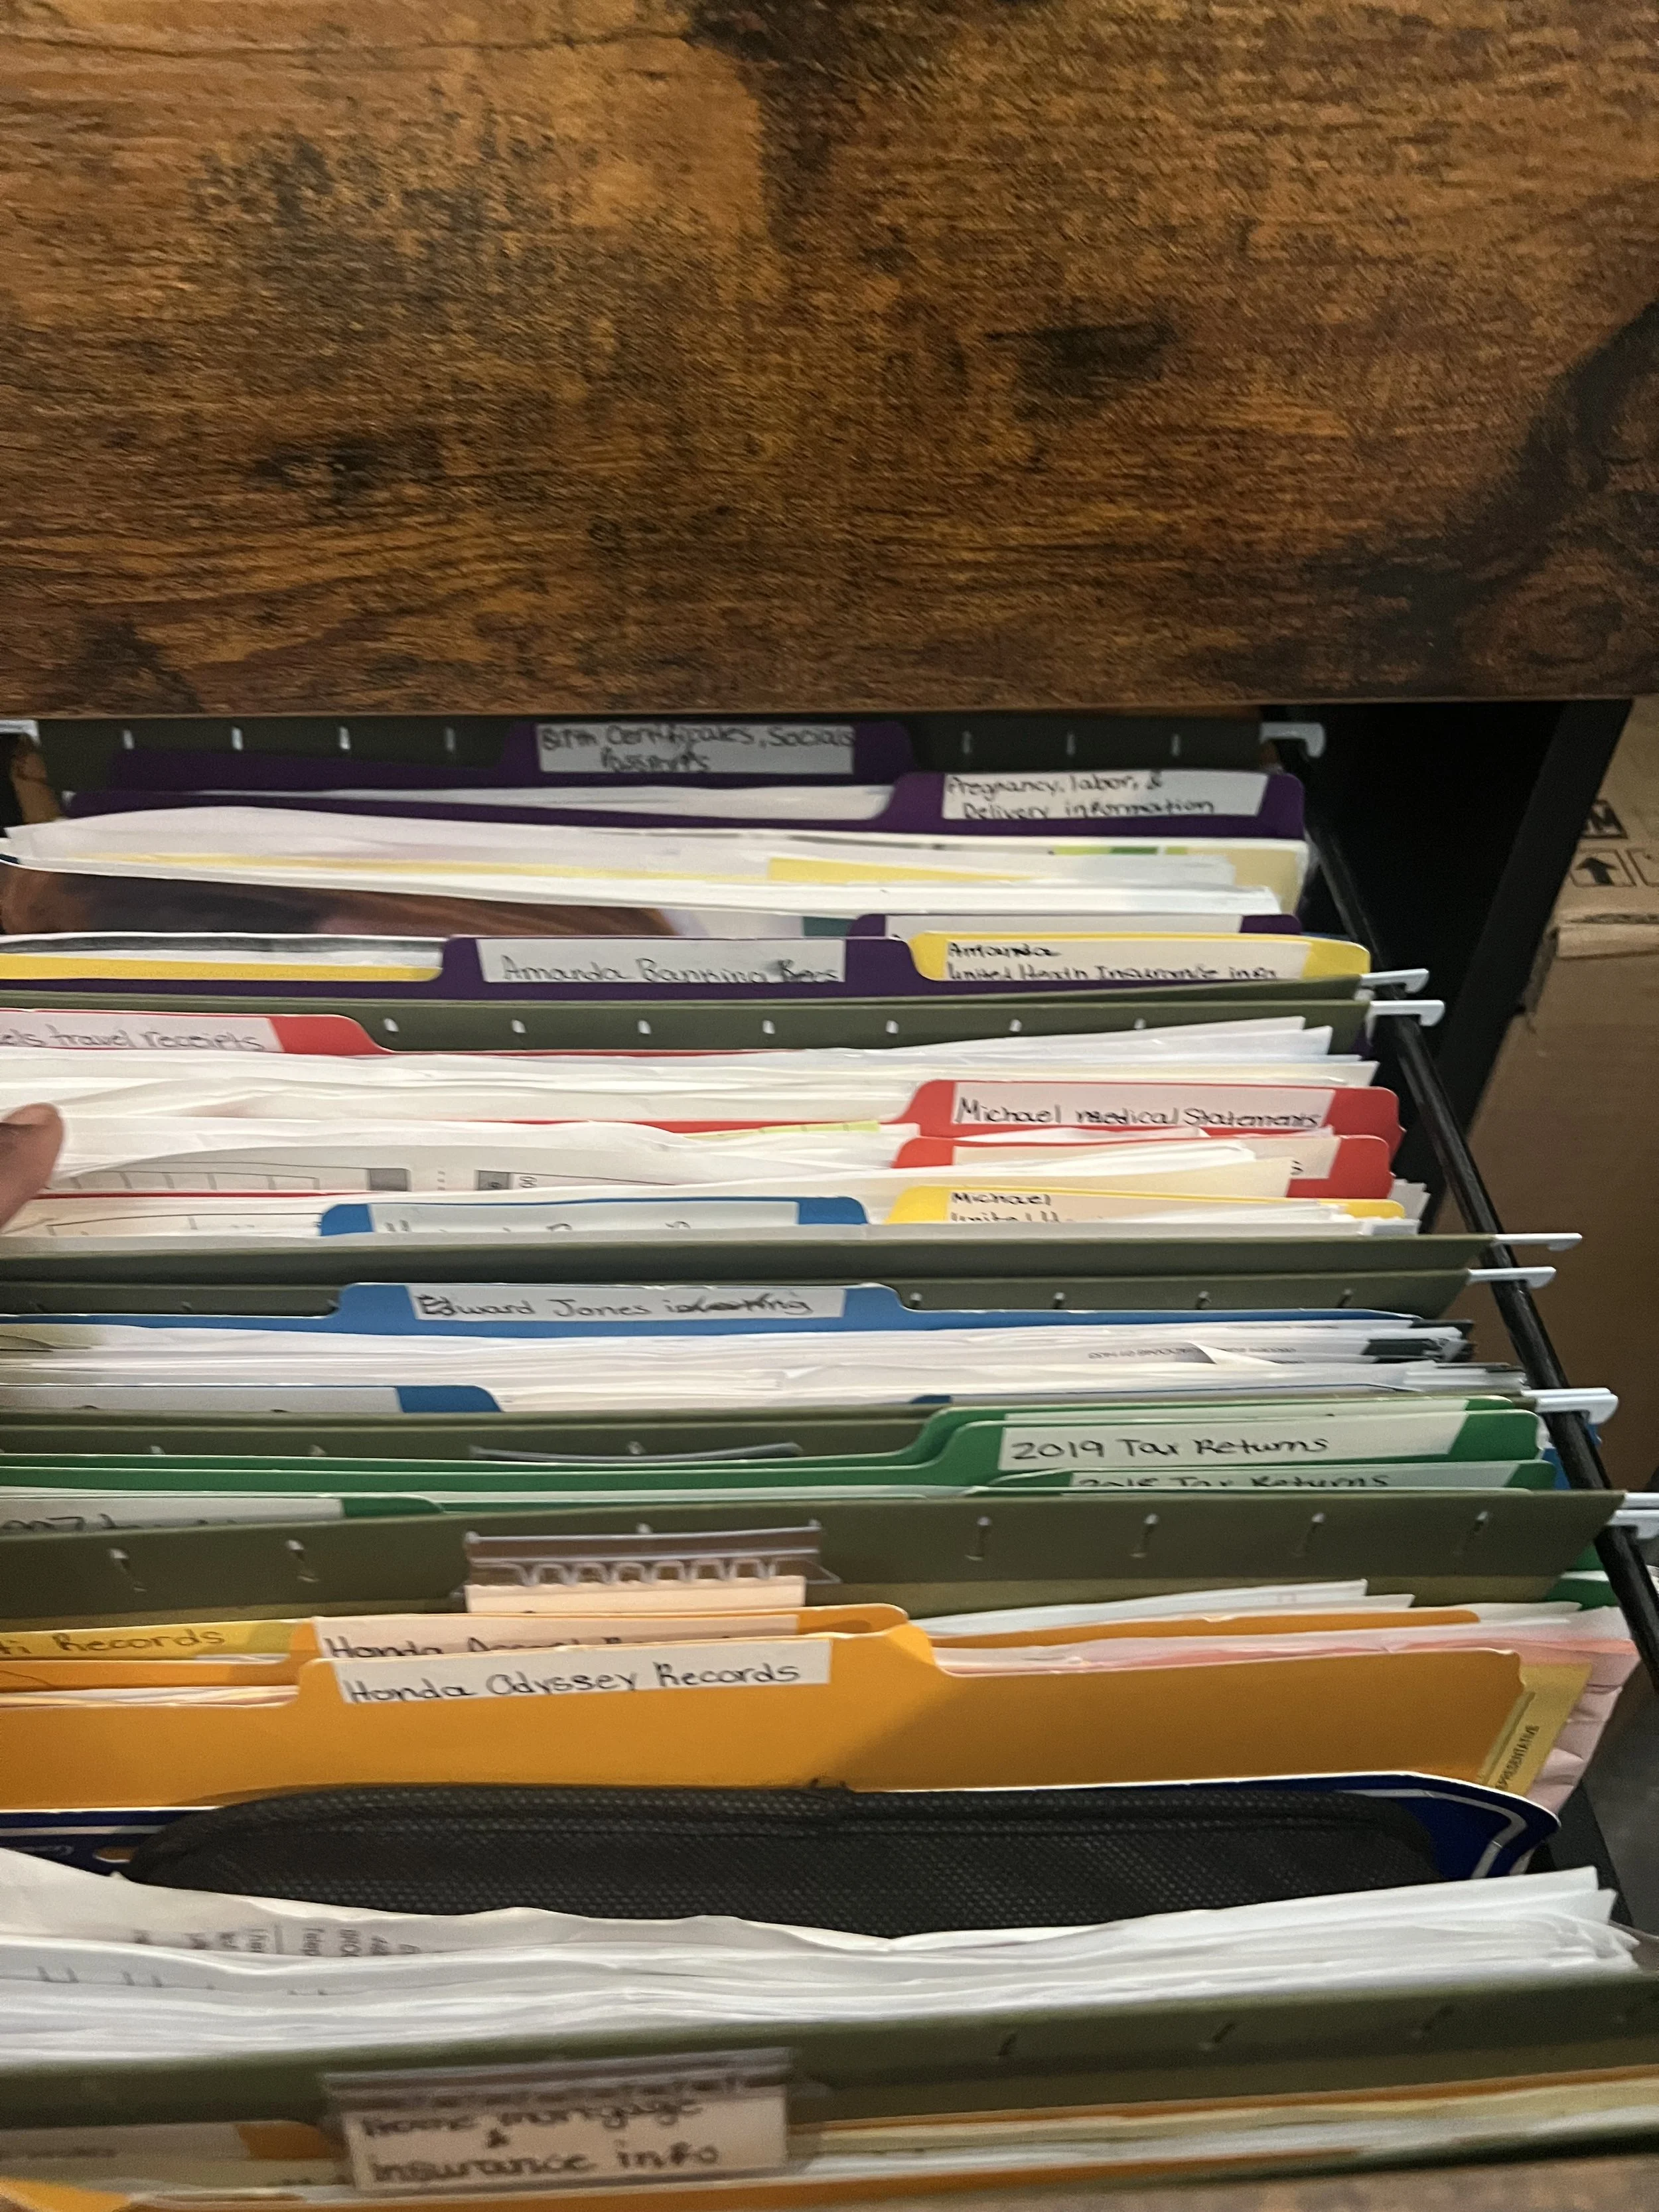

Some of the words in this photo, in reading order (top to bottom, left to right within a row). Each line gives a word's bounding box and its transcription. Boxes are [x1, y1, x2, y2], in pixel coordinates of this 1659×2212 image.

[948, 942, 1061, 958] Amanda
[501, 956, 626, 981] Amanda
[45, 1023, 133, 1049] travel
[954, 1096, 1060, 1123] Michael
[951, 1192, 1051, 1207] Michael
[415, 1294, 536, 1317] Edward
[549, 1298, 652, 1317] Jones
[1010, 1440, 1106, 1461] 2019
[1115, 1438, 1180, 1457] Tax
[1192, 1436, 1329, 1456] Returns
[52, 1628, 225, 1653] Records
[343, 1678, 472, 1704] Honda
[486, 1670, 638, 1697] Odyssey
[654, 1660, 801, 1687] Records
[613, 2139, 720, 2171] info
